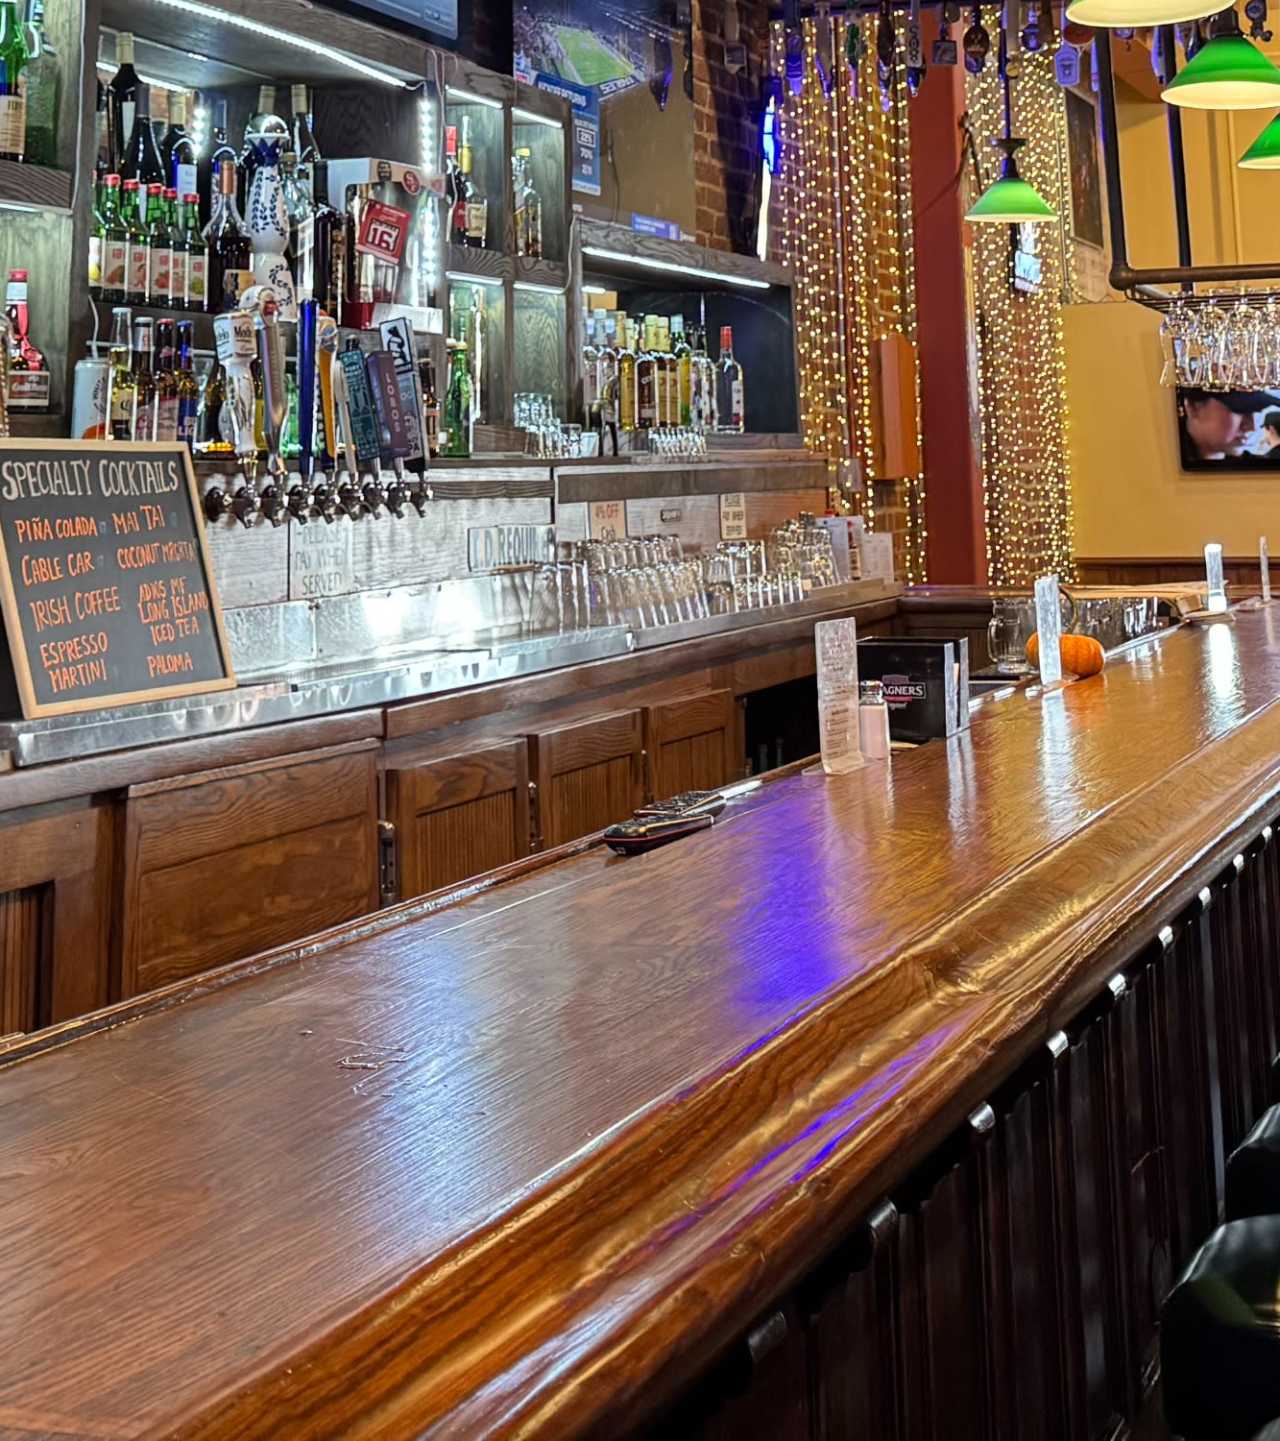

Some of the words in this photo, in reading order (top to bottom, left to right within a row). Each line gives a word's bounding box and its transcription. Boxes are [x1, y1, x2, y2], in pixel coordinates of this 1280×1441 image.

[1, 460, 91, 501] SPECIALTY
[99, 459, 179, 497] COCKTAILS
[15, 516, 53, 543] PIÑA
[56, 517, 98, 539] COLADA
[112, 511, 139, 535] MAI
[140, 505, 165, 530] TAI
[22, 555, 64, 587] CABLE
[68, 551, 95, 577] CAR
[117, 543, 160, 569] COCONUT
[30, 594, 73, 633] IRISH
[74, 586, 121, 621] COFFEE
[138, 597, 170, 625] LONG
[171, 591, 210, 618] ISLAND
[39, 631, 109, 669] ESPRESSO
[151, 622, 176, 647] ICED
[176, 615, 200, 639] TEA
[49, 658, 107, 692] MARTINI
[147, 651, 194, 678] PALOMA
[880, 684, 924, 698] AGNERS
